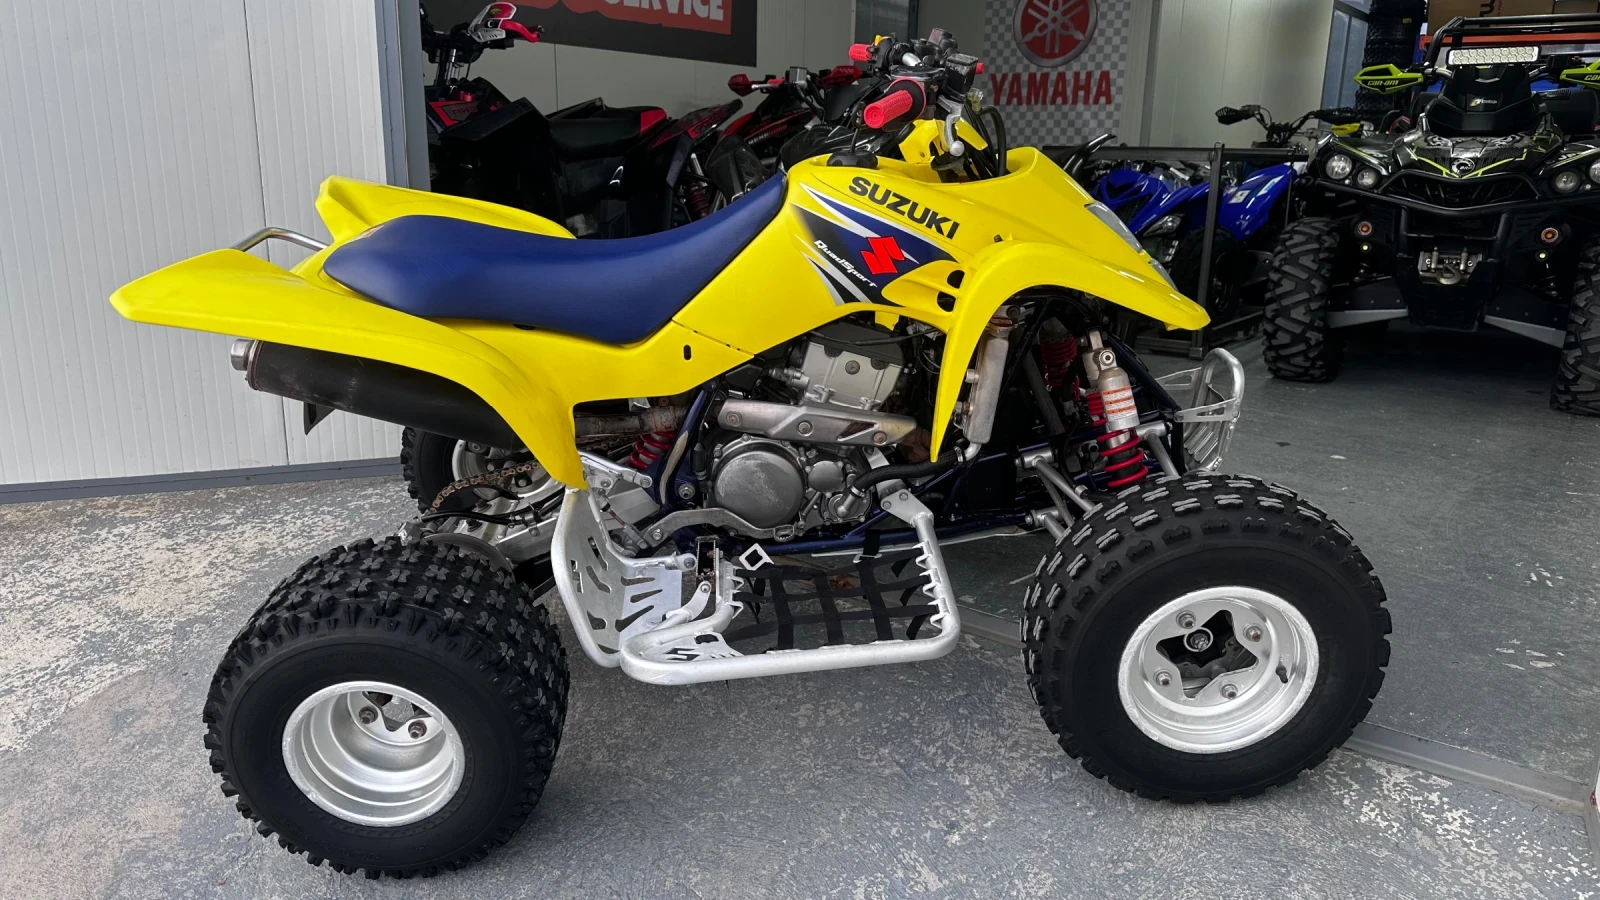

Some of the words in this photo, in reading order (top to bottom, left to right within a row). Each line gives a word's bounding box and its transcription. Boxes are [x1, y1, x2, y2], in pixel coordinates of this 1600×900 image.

[604, 0, 723, 21] VICE
[991, 70, 1112, 107] YAMAHA
[849, 176, 960, 240] SUZUKI
[814, 240, 878, 288] QuadSport
